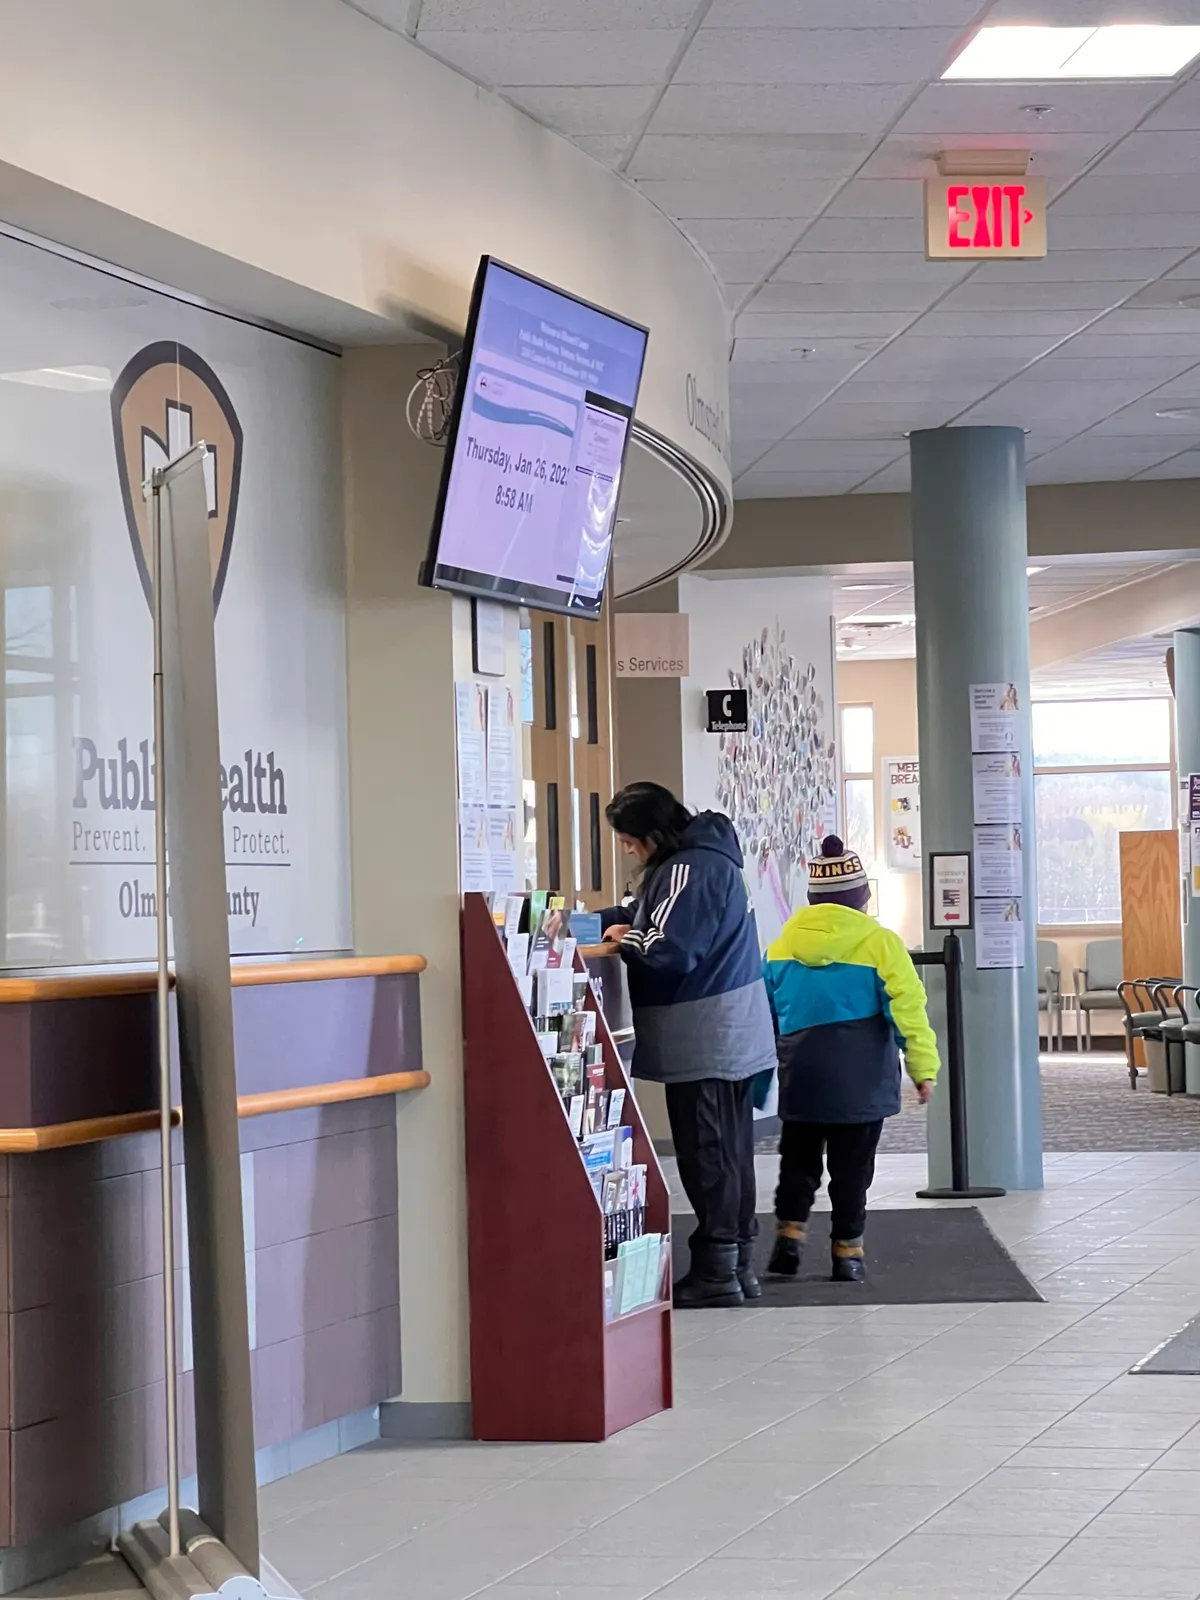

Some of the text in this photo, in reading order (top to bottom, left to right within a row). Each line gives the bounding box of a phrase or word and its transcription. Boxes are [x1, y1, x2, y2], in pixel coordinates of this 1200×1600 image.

[947, 185, 1025, 248] EXIT
[466, 436, 570, 487] Thursday, Jan 26, 202
[495, 485, 533, 513] 8:58 AM
[628, 656, 684, 672] Services
[711, 720, 747, 732] Telephone
[72, 737, 287, 815] Publ ealth
[72, 821, 290, 855] Prevent. Protect.
